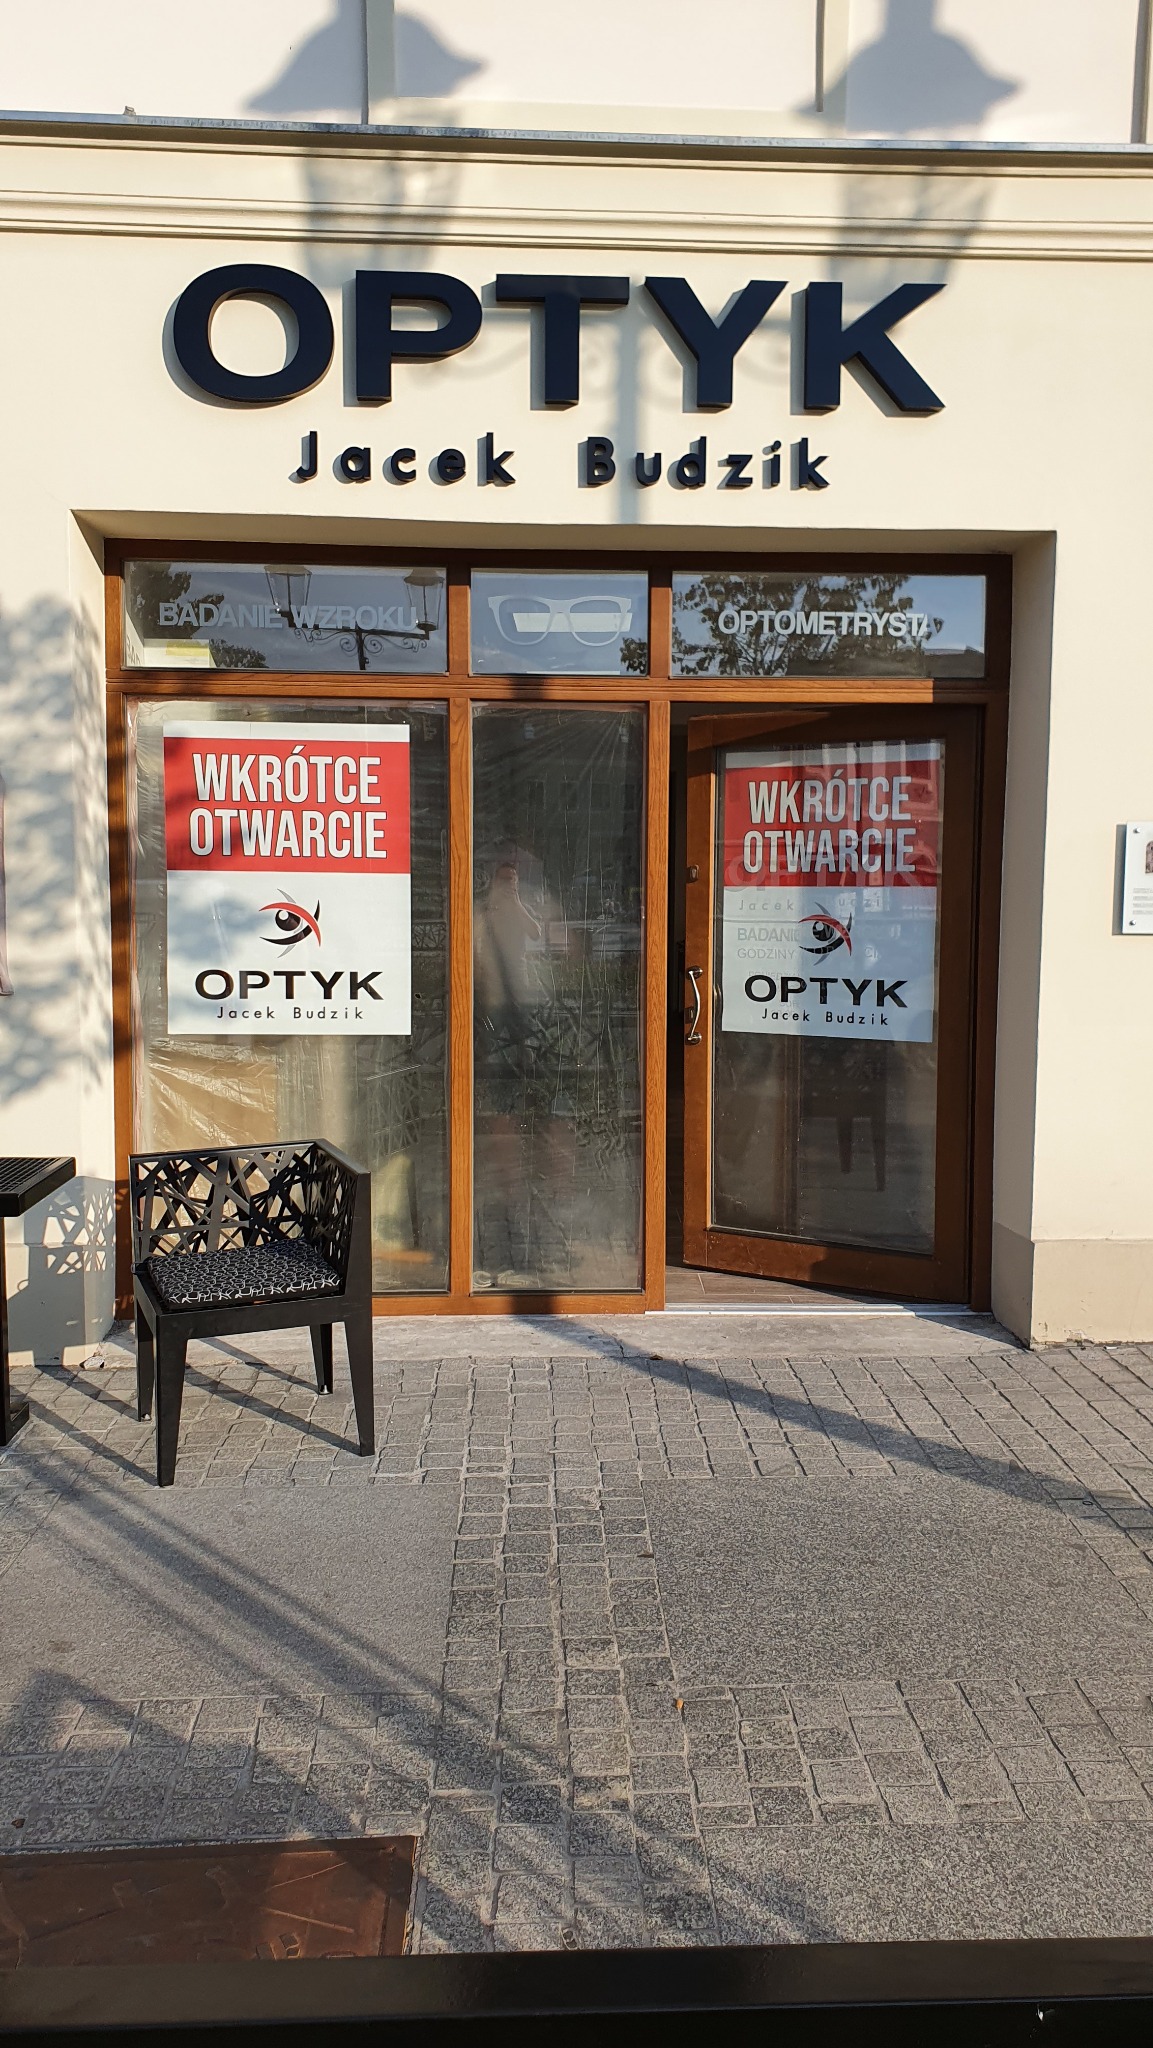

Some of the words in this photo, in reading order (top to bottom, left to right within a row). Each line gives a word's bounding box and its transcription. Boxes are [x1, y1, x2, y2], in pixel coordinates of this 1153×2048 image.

[171, 263, 947, 412] OPTYK
[296, 430, 515, 486] Jacek
[585, 434, 830, 489] Budzik
[158, 602, 283, 629] BADANIE
[290, 604, 418, 632] WZROKU
[192, 744, 381, 804] WKRÓTCE
[748, 768, 912, 825] WKRÓTCE
[189, 807, 388, 859] OTWARCIE
[743, 827, 917, 874] OTWARCIE
[737, 947, 796, 960] GODZINY
[195, 969, 385, 1001] OPTYK
[744, 974, 909, 1008] OPTYK
[216, 1006, 276, 1019] Jacek
[293, 1006, 364, 1020] Budzik
[761, 1008, 811, 1022] Jacek
[825, 1011, 889, 1026] Budzik
